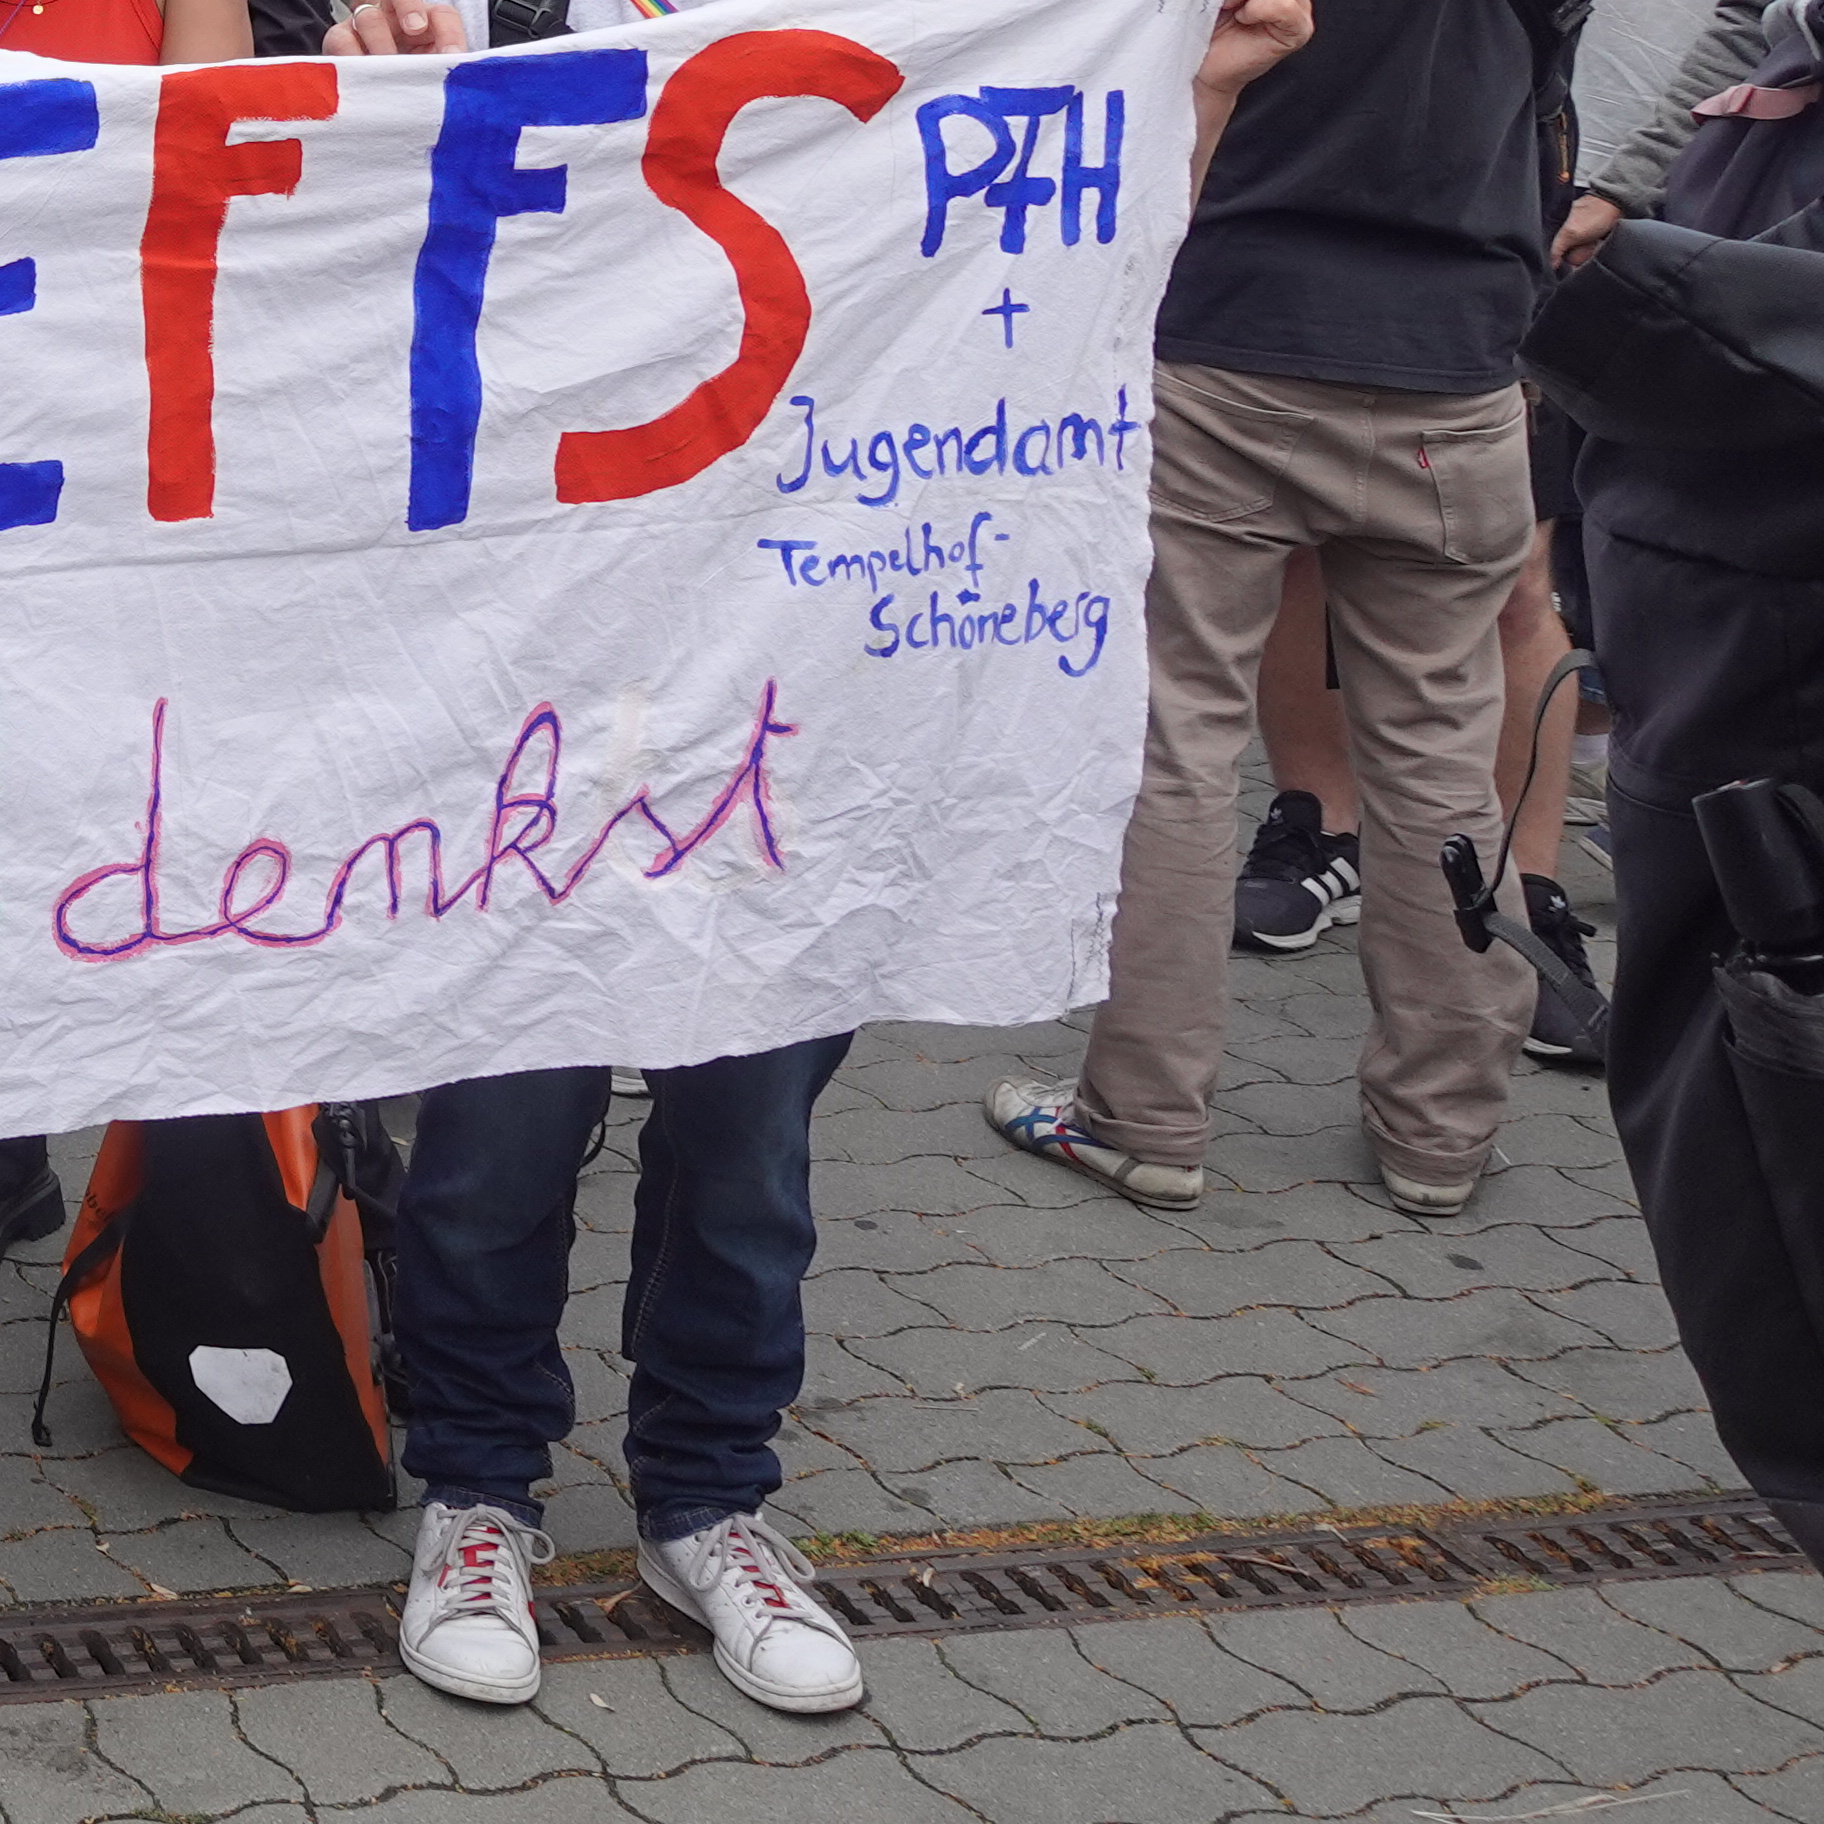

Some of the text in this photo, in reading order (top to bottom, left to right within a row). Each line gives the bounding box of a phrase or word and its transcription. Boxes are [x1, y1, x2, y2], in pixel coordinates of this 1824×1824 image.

[777, 383, 1140, 507] Jugendamt
[757, 512, 1009, 593] Tempelhof-
[864, 579, 1110, 677] Schöneberg
[52, 677, 799, 963] denkst
